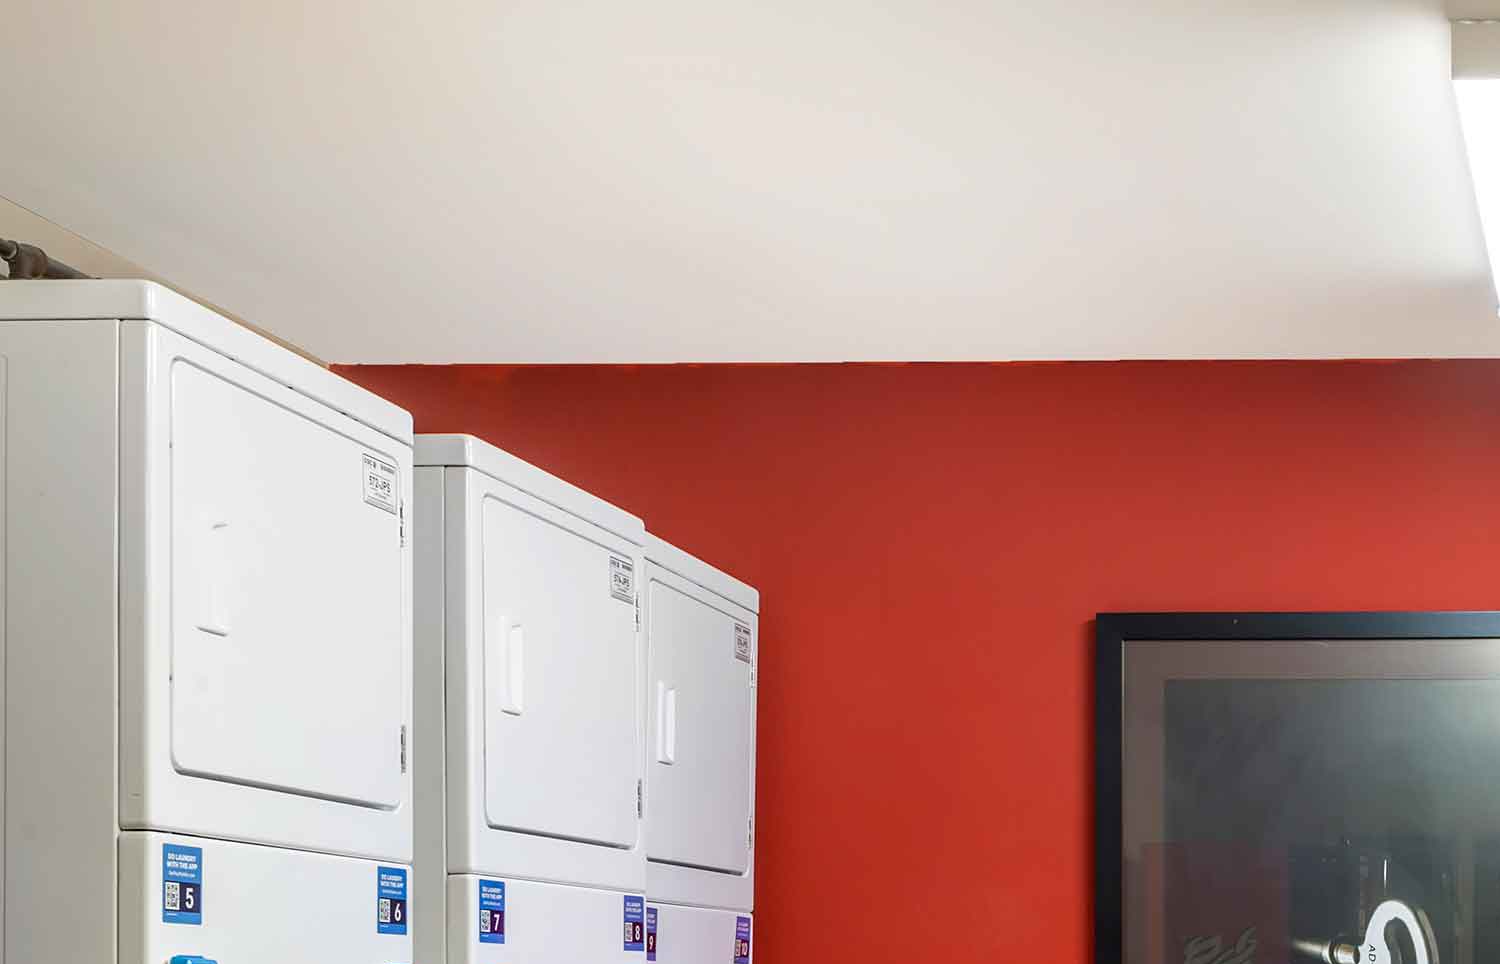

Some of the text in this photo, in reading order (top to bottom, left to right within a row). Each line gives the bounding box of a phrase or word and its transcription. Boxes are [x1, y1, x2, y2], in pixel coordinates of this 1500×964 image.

[184, 887, 195, 910] 5
[394, 903, 402, 922] 6
[493, 913, 501, 932] 7
[634, 925, 641, 941] 8
[648, 935, 654, 950] 9
